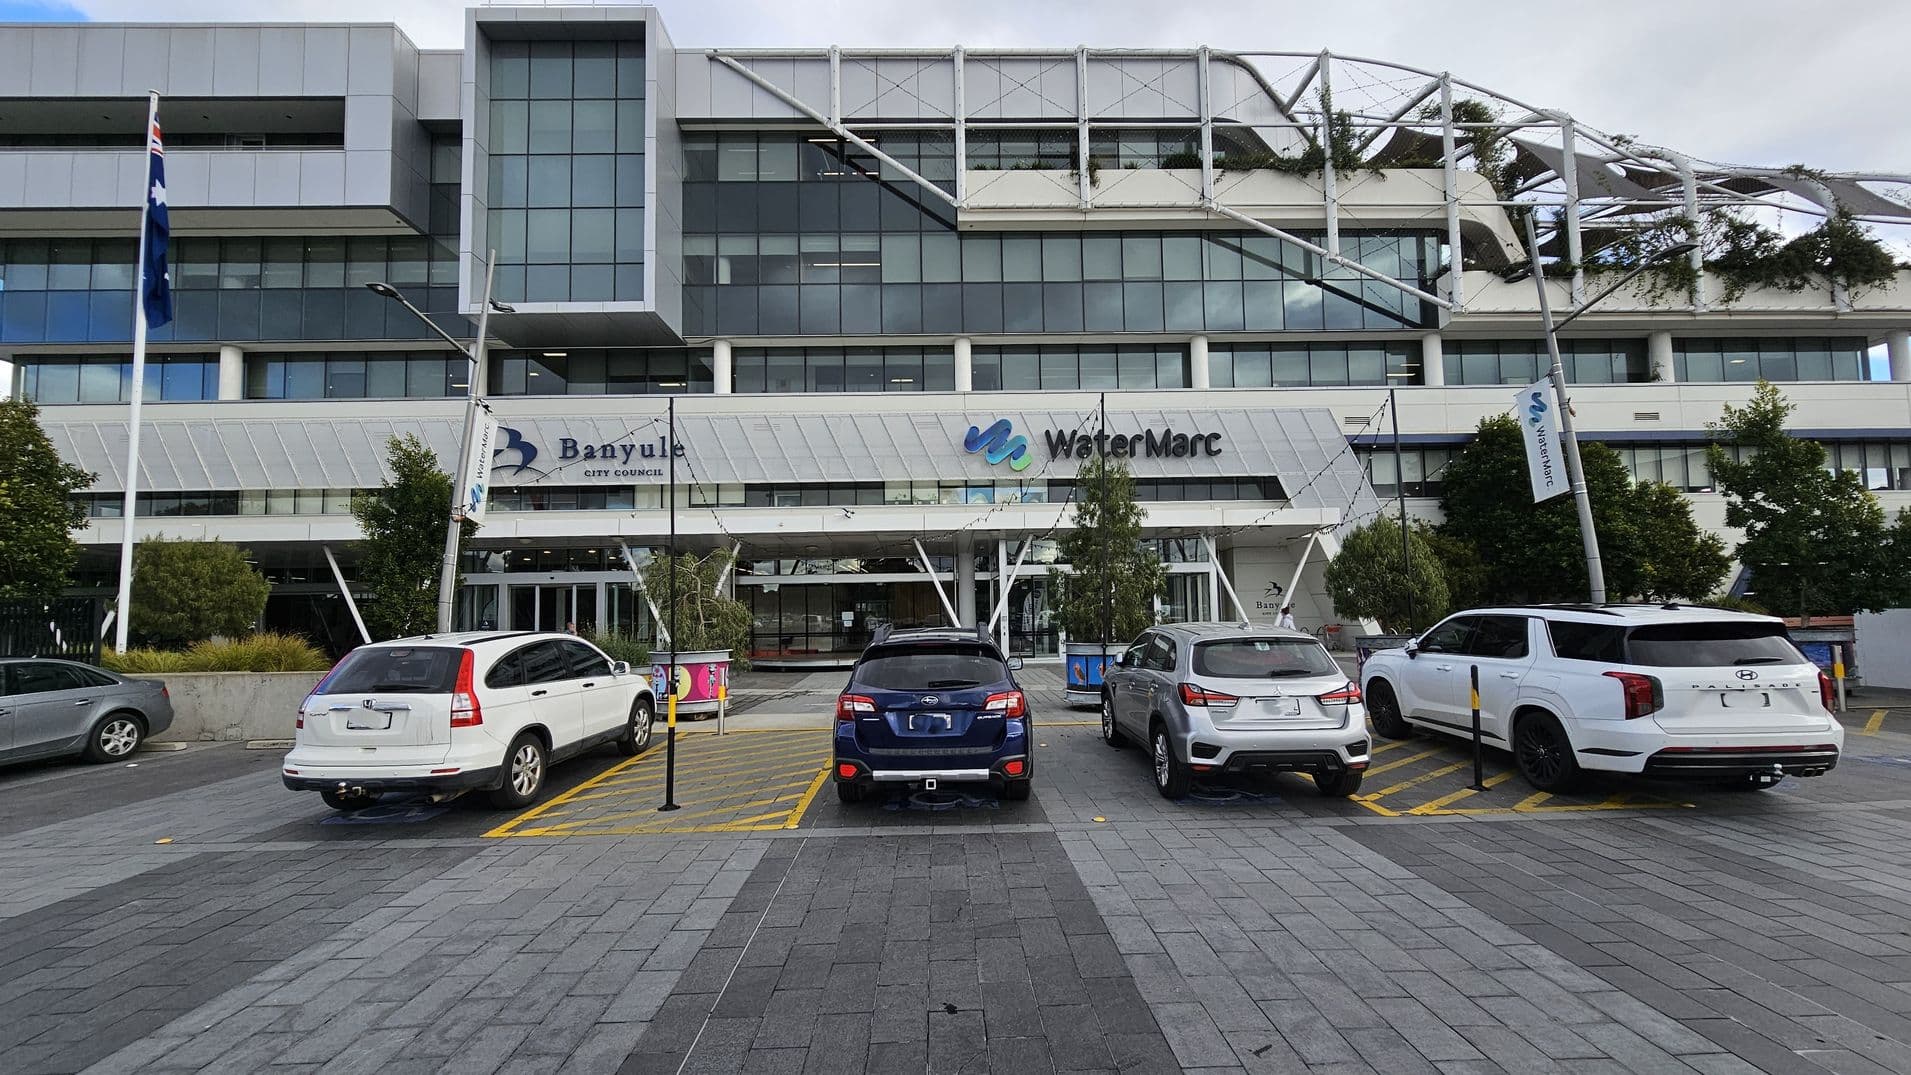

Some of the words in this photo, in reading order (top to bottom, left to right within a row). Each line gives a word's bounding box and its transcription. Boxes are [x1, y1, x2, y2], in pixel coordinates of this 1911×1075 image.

[476, 423, 490, 479] WaterMarc
[559, 436, 685, 465] Banyule
[1044, 428, 1222, 459] WaterMarc
[1536, 425, 1554, 487] WaterMarc
[584, 469, 610, 477] CITY
[614, 469, 664, 477] COUNCIL
[1256, 601, 1296, 611] Banye
